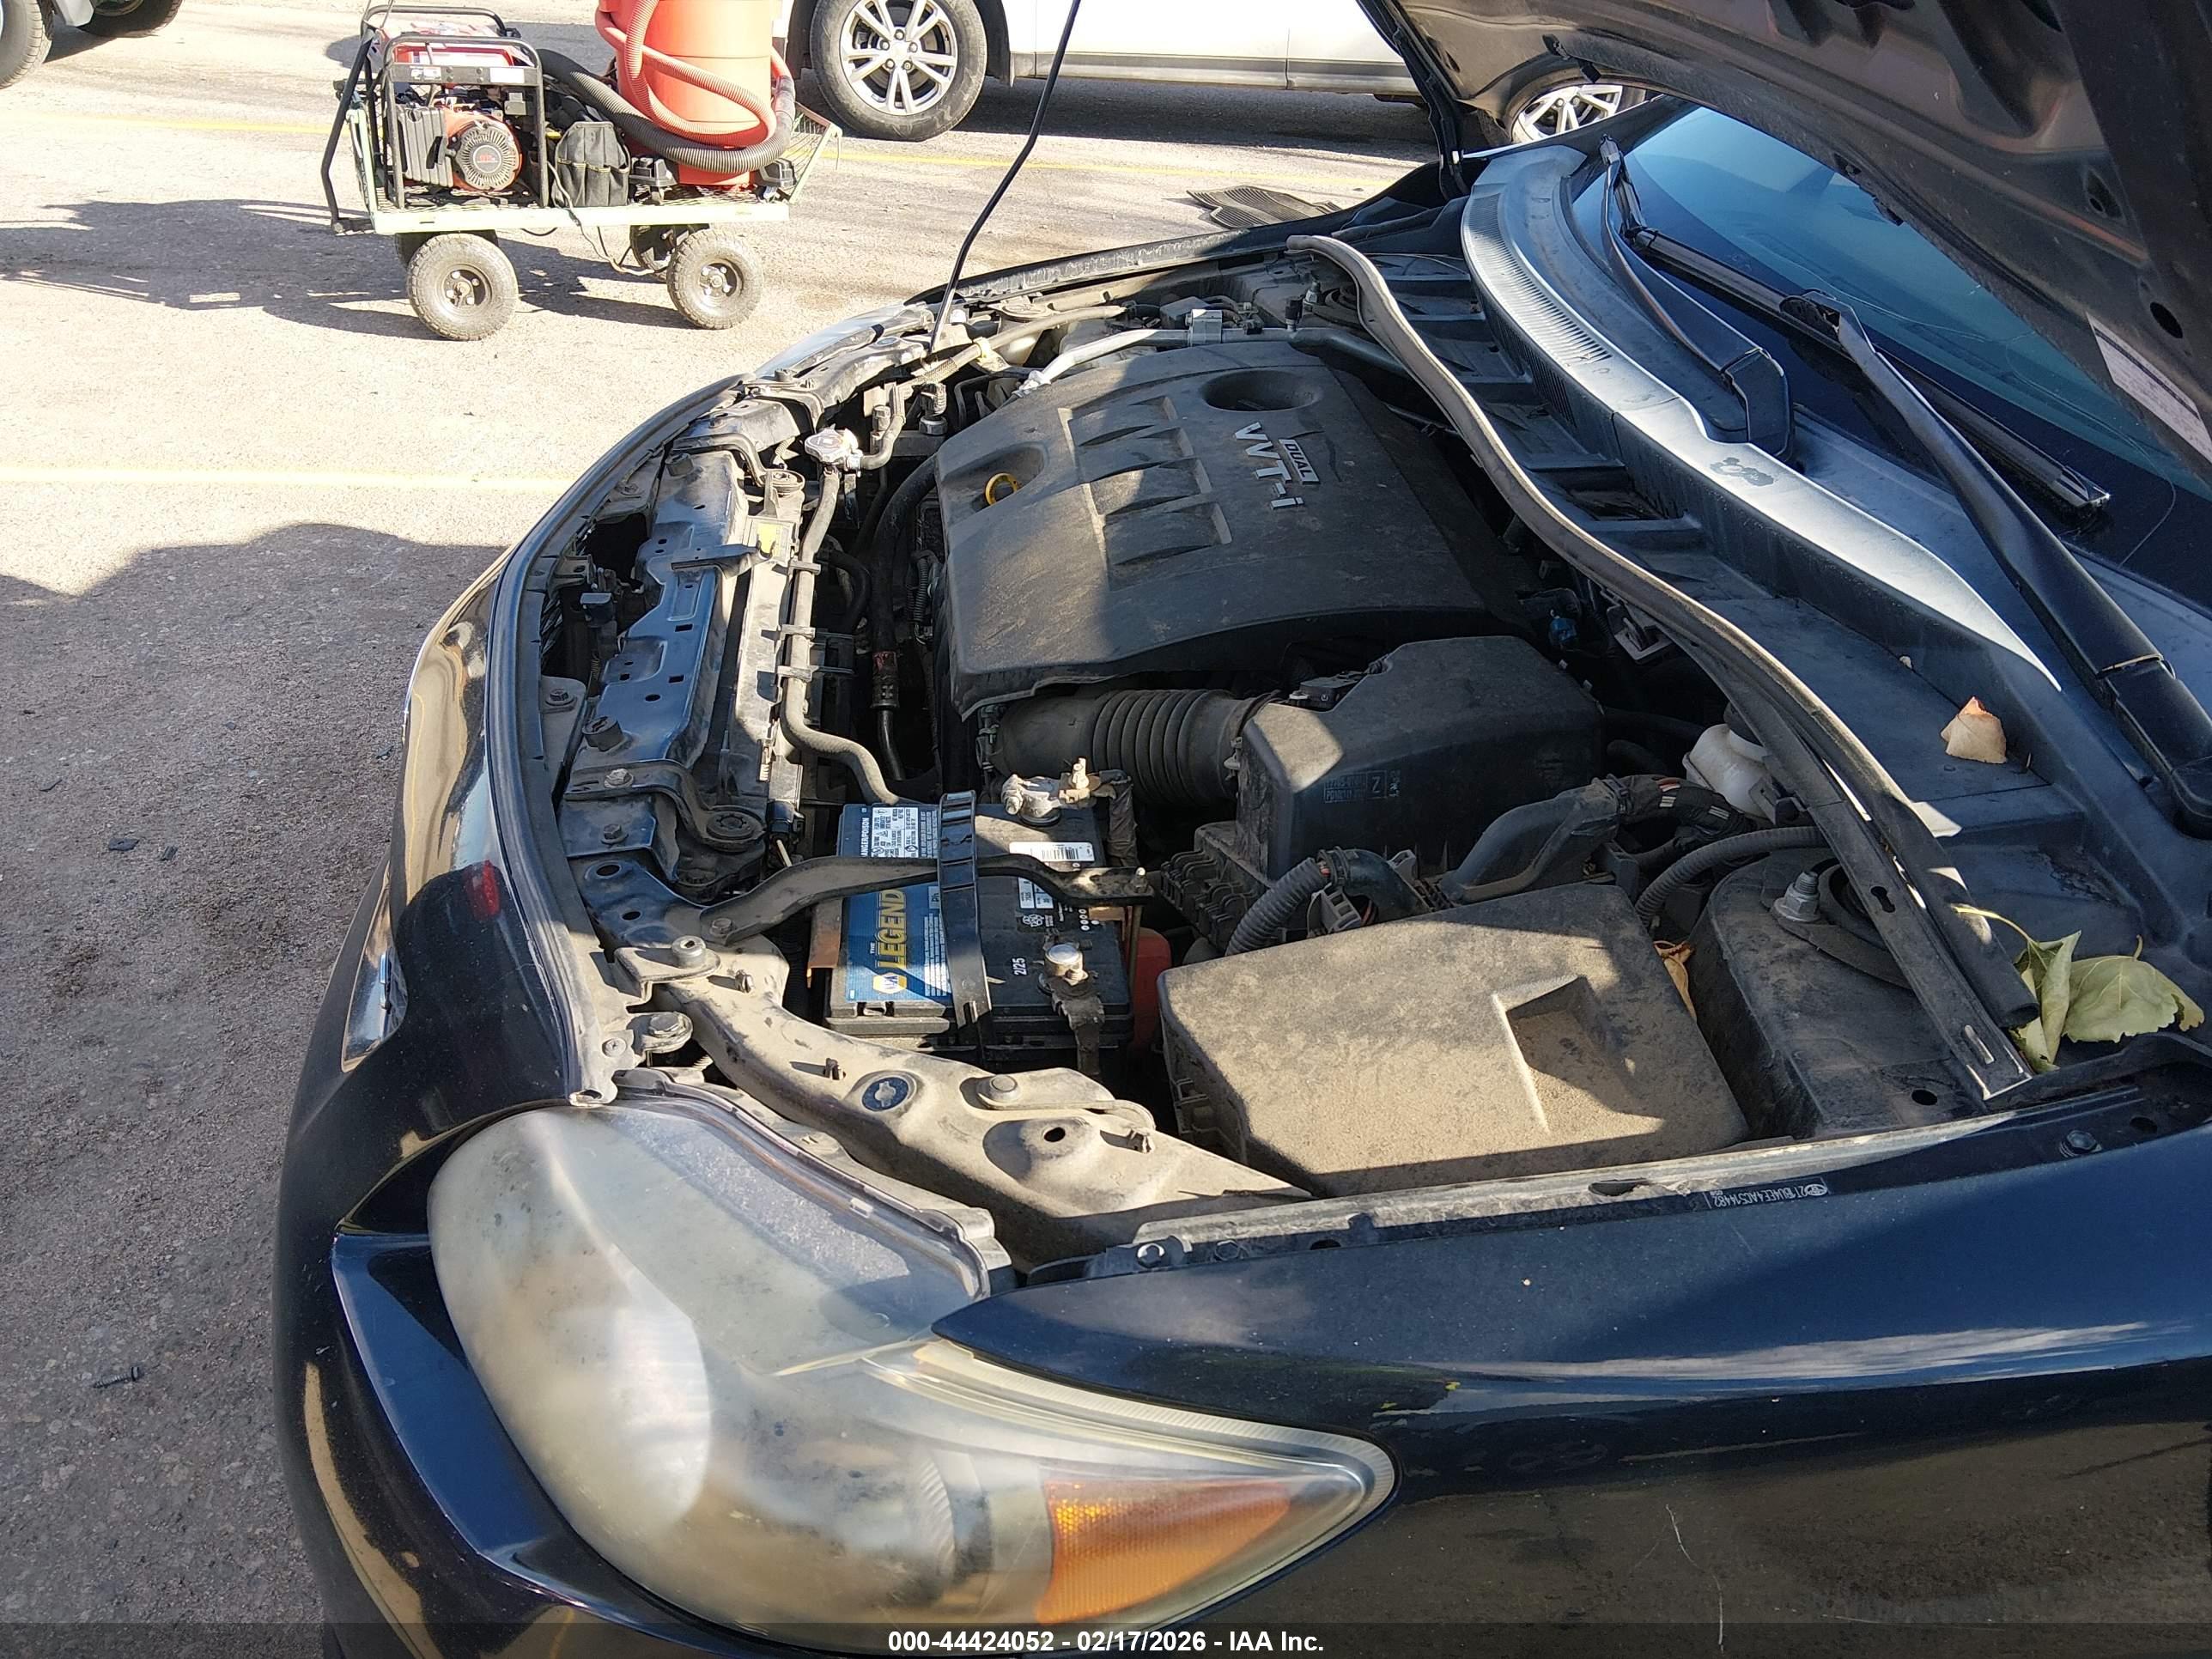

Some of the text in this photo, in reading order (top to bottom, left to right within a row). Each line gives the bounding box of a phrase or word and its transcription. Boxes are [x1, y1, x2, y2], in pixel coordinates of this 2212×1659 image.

[1234, 421, 1304, 510] VVT-i
[1285, 442, 1314, 478] DUAL
[860, 817, 870, 857] ANGER/POISON
[874, 889, 908, 969] LEGEND
[1012, 957, 1028, 975] 2/25
